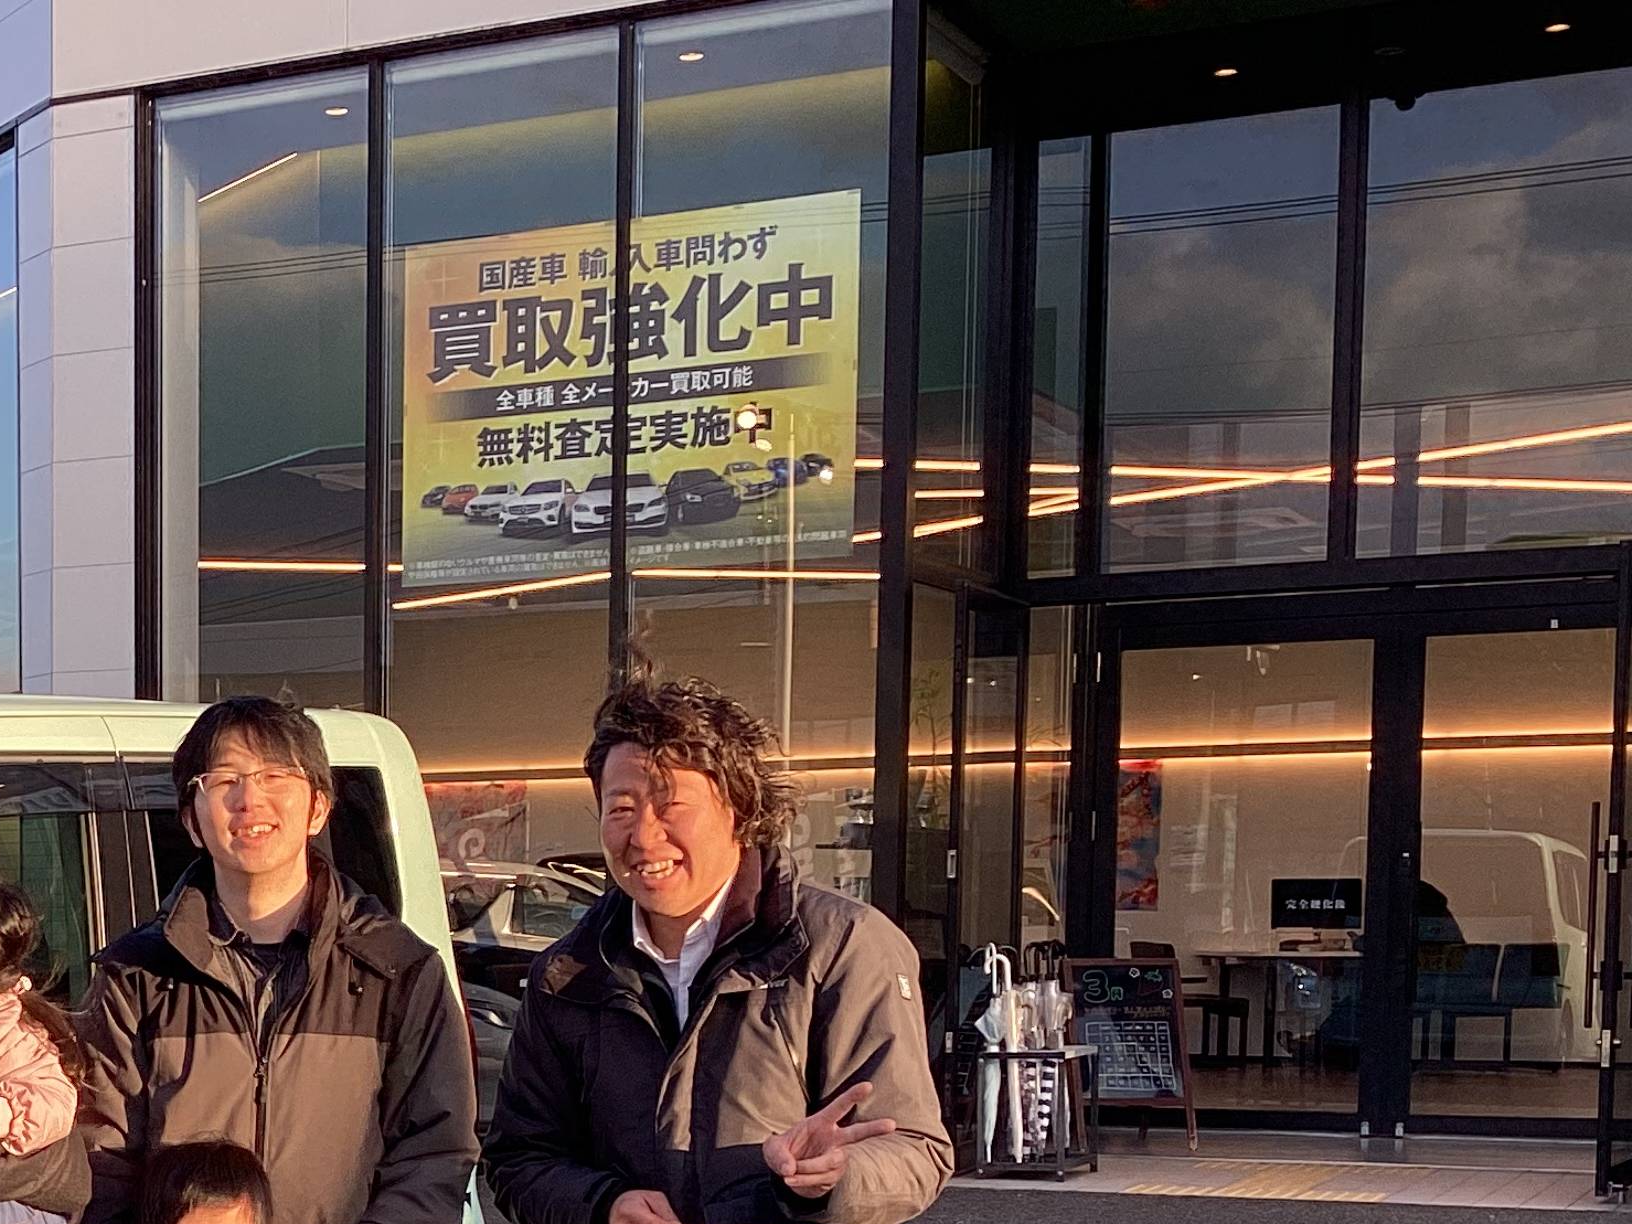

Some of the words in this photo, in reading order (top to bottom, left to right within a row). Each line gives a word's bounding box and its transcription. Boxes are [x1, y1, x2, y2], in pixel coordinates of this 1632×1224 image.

[479, 253, 567, 292] 国産車
[578, 225, 778, 281] 輸入車問わず
[427, 262, 833, 383] 買取強化中
[496, 385, 554, 411] 全車種
[561, 365, 753, 406] 全メーカー買取可能
[477, 403, 772, 467] 無料査定実施中
